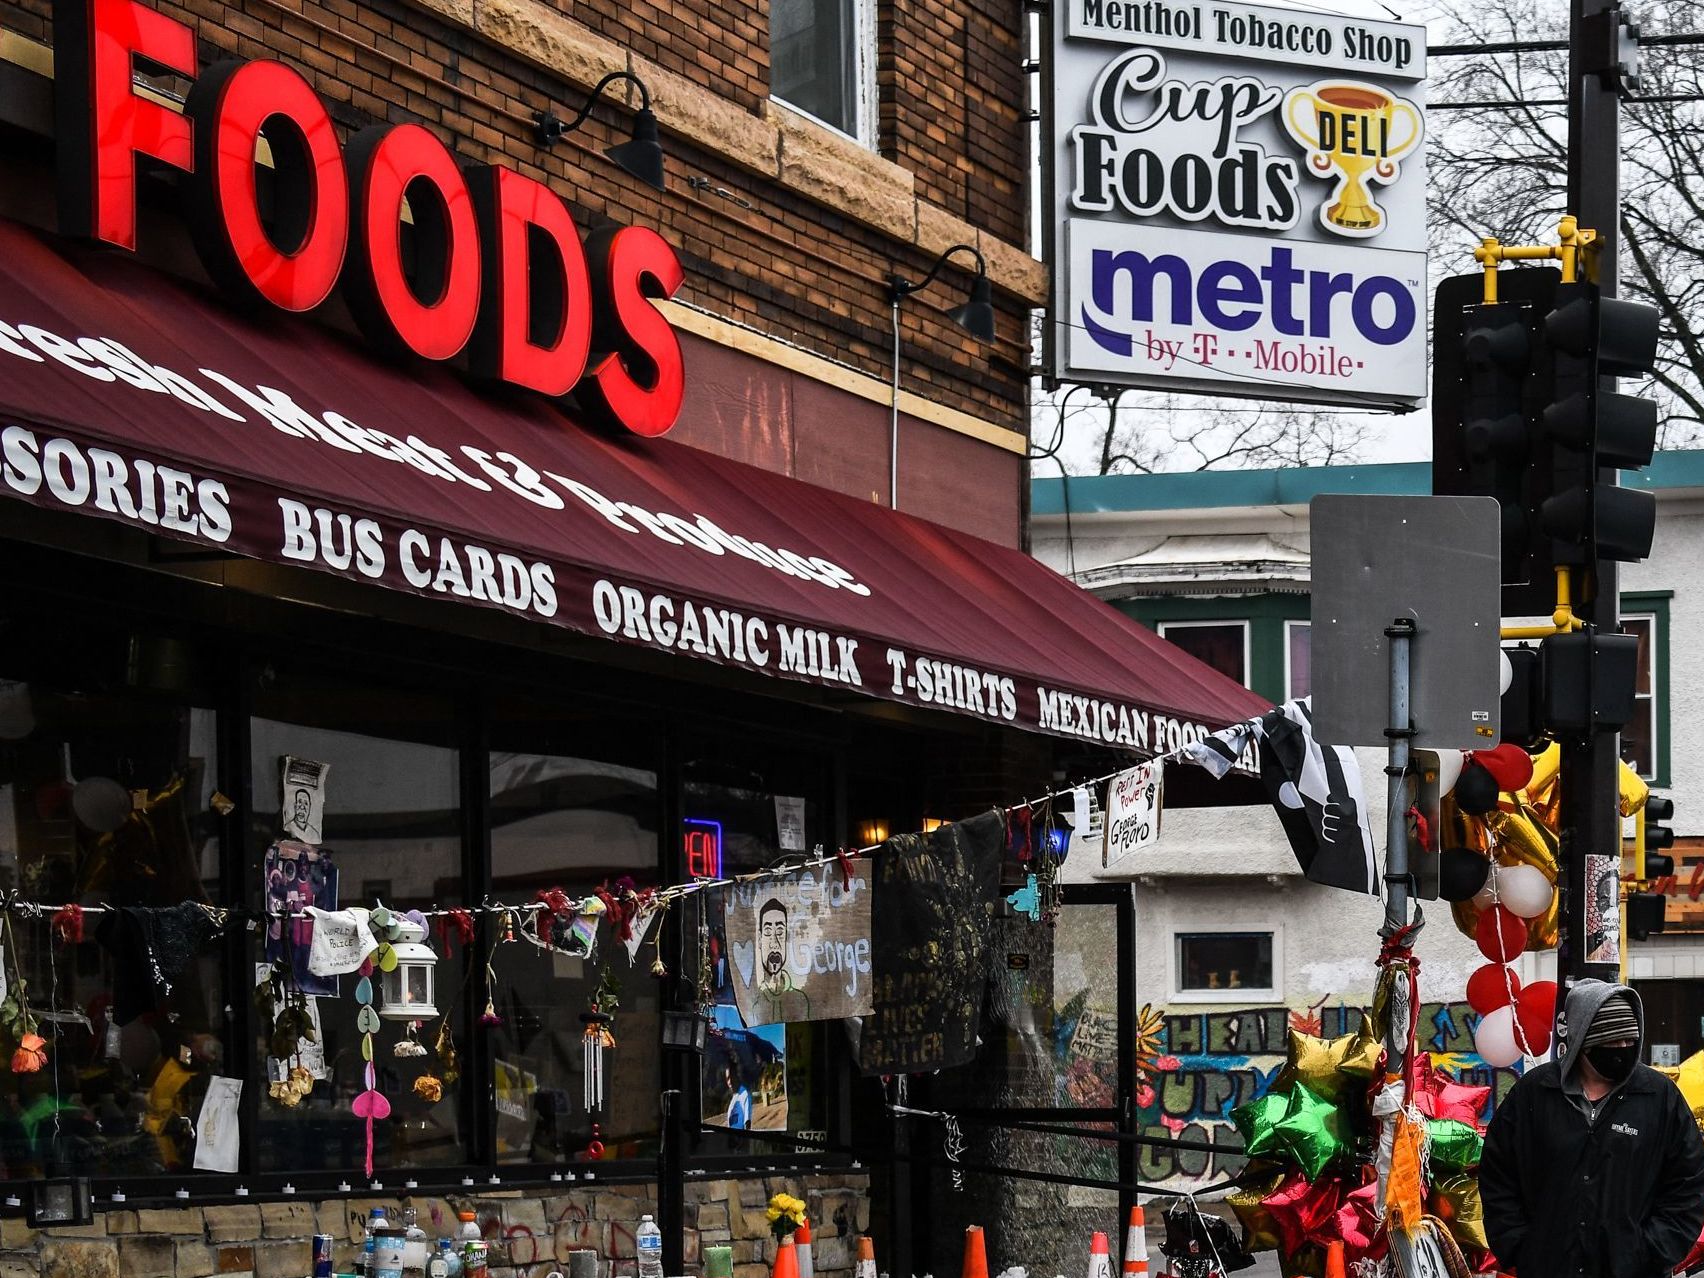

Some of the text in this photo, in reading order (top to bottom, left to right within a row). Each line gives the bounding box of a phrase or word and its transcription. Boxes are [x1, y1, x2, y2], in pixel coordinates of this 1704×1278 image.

[1082, 0, 1412, 69] Menthol Tobacco Shop
[1099, 54, 1278, 158] Cup
[1319, 110, 1388, 158] DELI
[1079, 131, 1294, 223] Foods
[93, 0, 686, 437] FOODS
[1082, 247, 1416, 357] metro
[0, 322, 211, 412] resh
[1145, 330, 1184, 371] by
[1, 426, 233, 544] SORIES
[278, 497, 558, 618] BUS CARDS
[592, 577, 862, 685] ORGANIC MILK
[886, 647, 1017, 721] T-SHIRTS
[1038, 685, 1149, 751] MEXICAN
[685, 831, 718, 878] EN
[788, 937, 872, 998] George
[1163, 1008, 1289, 1056] HEAL
